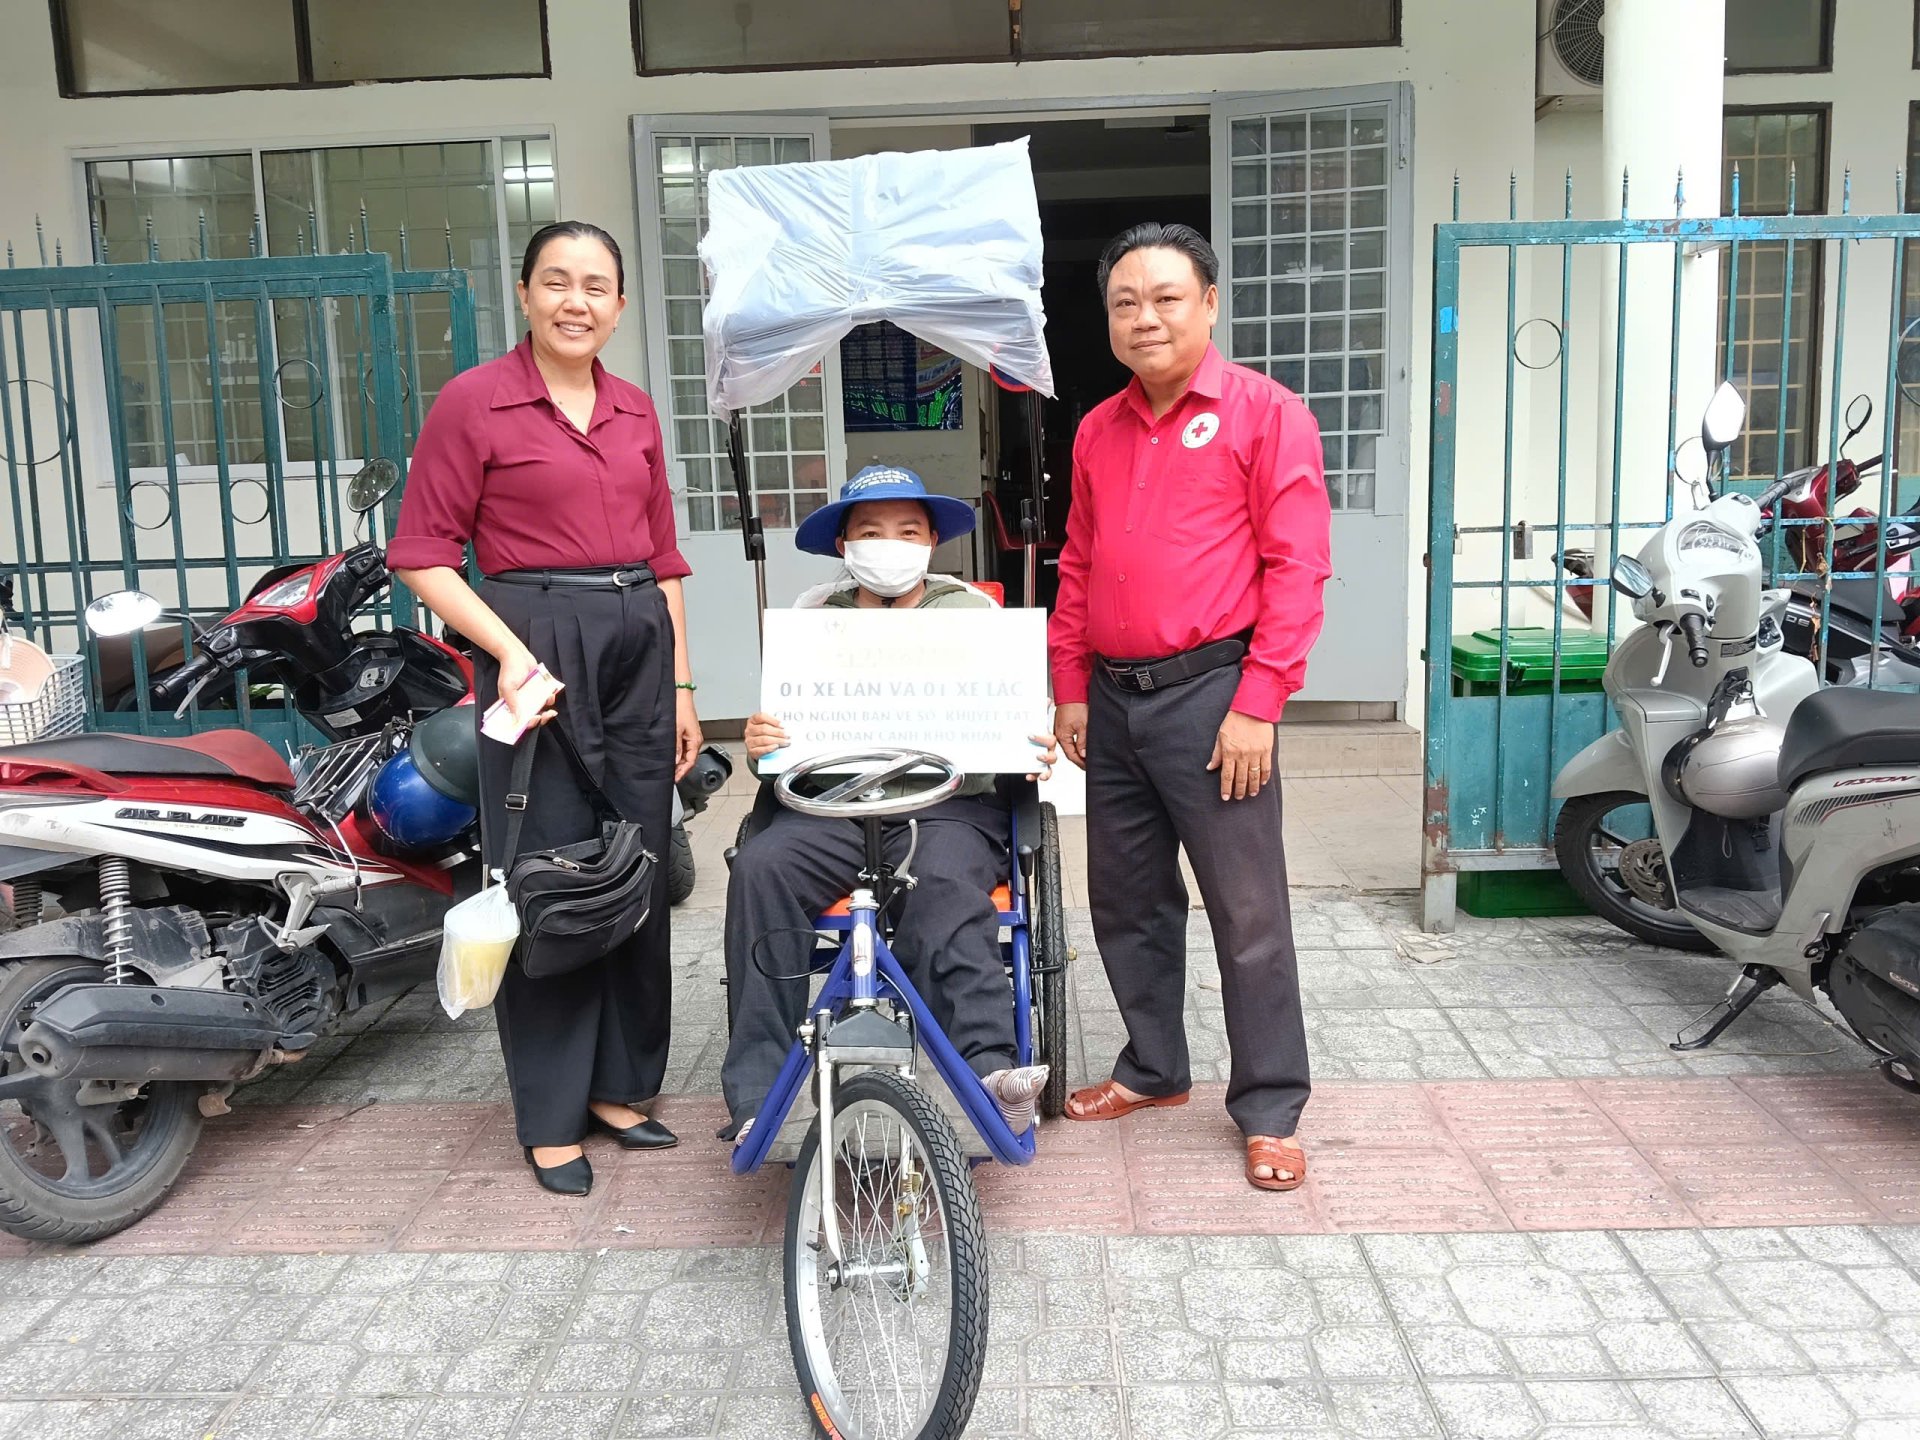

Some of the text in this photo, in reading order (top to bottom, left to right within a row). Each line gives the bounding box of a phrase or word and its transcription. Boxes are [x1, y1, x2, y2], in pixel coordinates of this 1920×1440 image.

[780, 682, 802, 697] 01
[813, 682, 836, 697] XE
[922, 681, 946, 697] 01
[956, 681, 979, 697] XE
[1832, 775, 1917, 788] VISION
[115, 807, 248, 828] AIR BLADE
